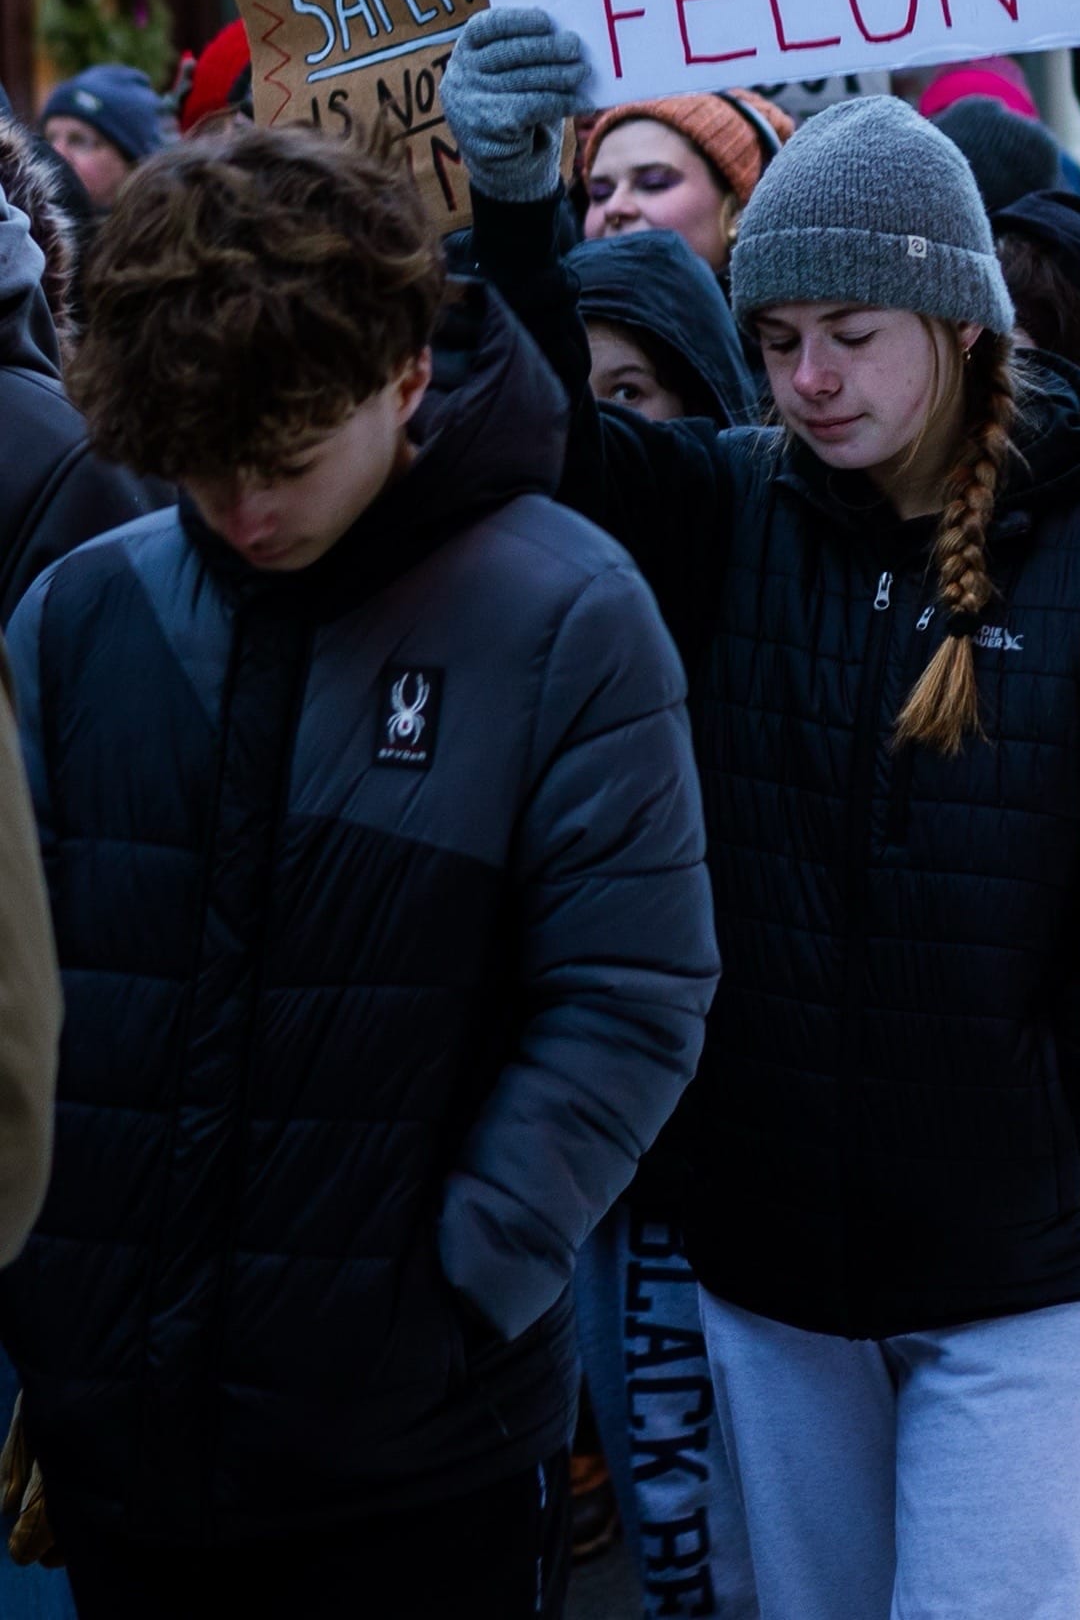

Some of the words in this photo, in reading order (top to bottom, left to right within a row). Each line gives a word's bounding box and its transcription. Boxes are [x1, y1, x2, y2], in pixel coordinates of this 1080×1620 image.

[311, 88, 353, 140] IS
[980, 625, 1003, 637] DIE
[971, 636, 1004, 648] AUER
